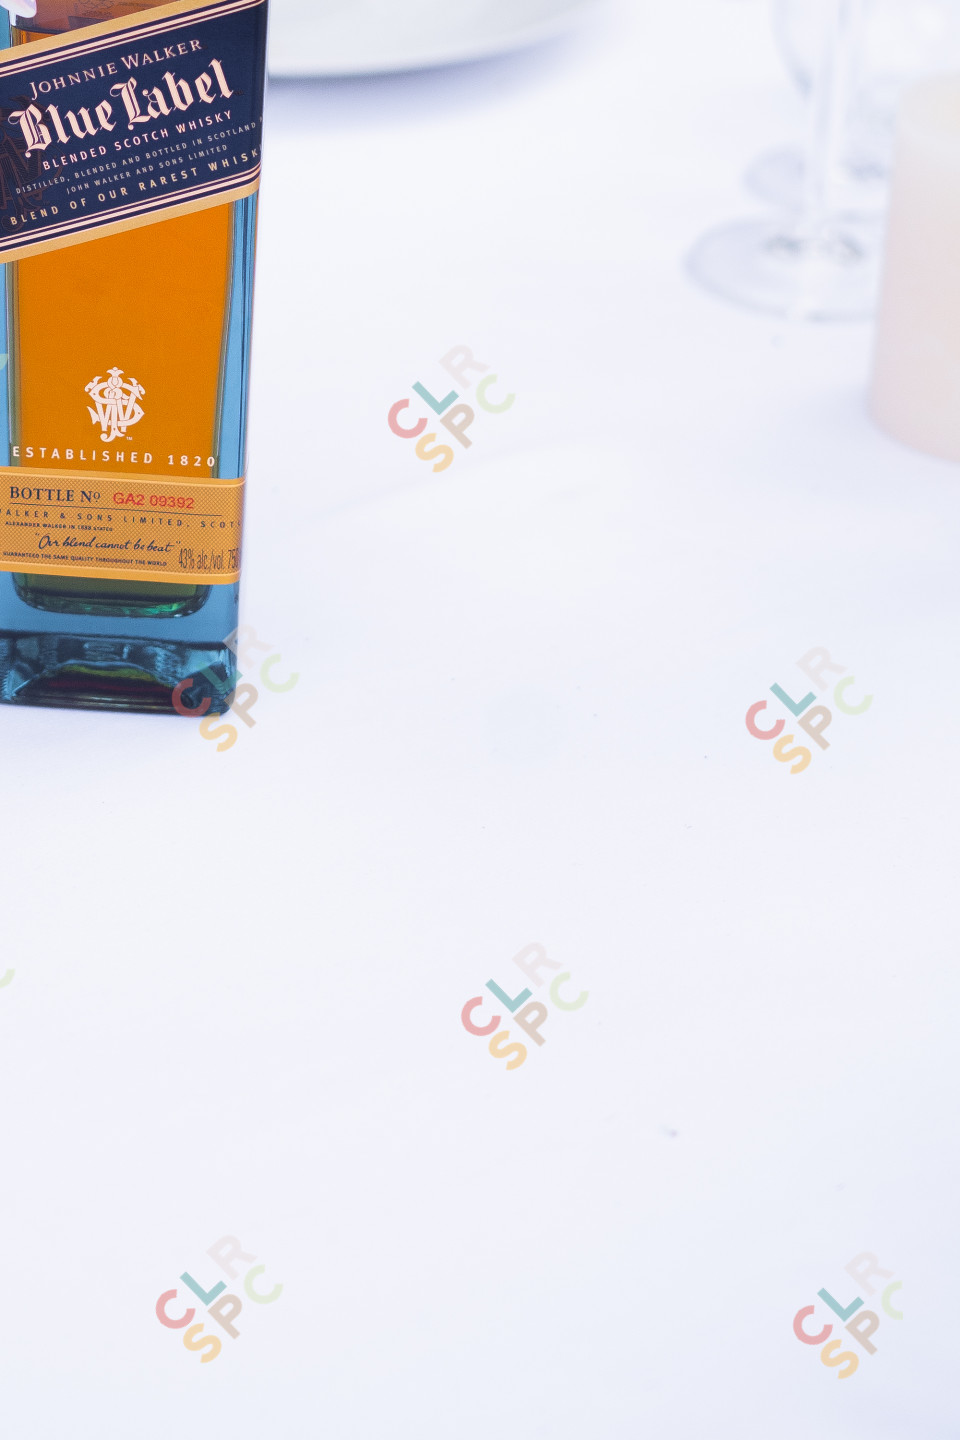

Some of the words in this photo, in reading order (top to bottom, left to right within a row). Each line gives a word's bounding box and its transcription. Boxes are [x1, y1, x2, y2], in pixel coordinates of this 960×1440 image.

[29, 62, 118, 101] JOHNNIE
[120, 39, 202, 70] WALKER
[7, 99, 117, 158] Blue
[110, 58, 234, 131] Label
[15, 175, 71, 195] DISTILLED,
[74, 161, 117, 179] BLENDED
[122, 155, 140, 167] AND
[145, 142, 187, 160] BOTTLED
[192, 137, 203, 148] IN
[207, 121, 256, 142] SCOTLAND
[43, 145, 107, 171] BLENDED
[115, 128, 169, 152] SCOTCH
[175, 110, 232, 134] WHISKY
[66, 182, 90, 196] JOHN
[93, 171, 132, 187] WALKER
[136, 164, 154, 177] AND
[159, 156, 184, 170] SONS
[188, 143, 228, 161] LIMITED
[10, 206, 59, 227] BLEND
[69, 197, 88, 210] OF
[97, 187, 128, 203] OUR
[138, 167, 198, 192] RAREST
[12, 445, 153, 464] ESTABLISHED
[168, 454, 215, 467] 1820
[10, 486, 74, 502] BOTTLE
[112, 492, 145, 506] GA2
[150, 495, 195, 509] 09392
[60, 512, 66, 520] &
[77, 512, 112, 521] SONS
[3, 550, 39, 559] GUARANTEED
[41, 552, 52, 560] THE
[53, 553, 69, 561] SAME
[95, 556, 133, 564] THROUGHOUT
[135, 558, 146, 566] THE
[147, 559, 167, 567] WORLD
[62, 536, 96, 548] blend
[95, 539, 131, 550] cannot
[133, 538, 146, 551] be
[179, 547, 194, 570] 43%
